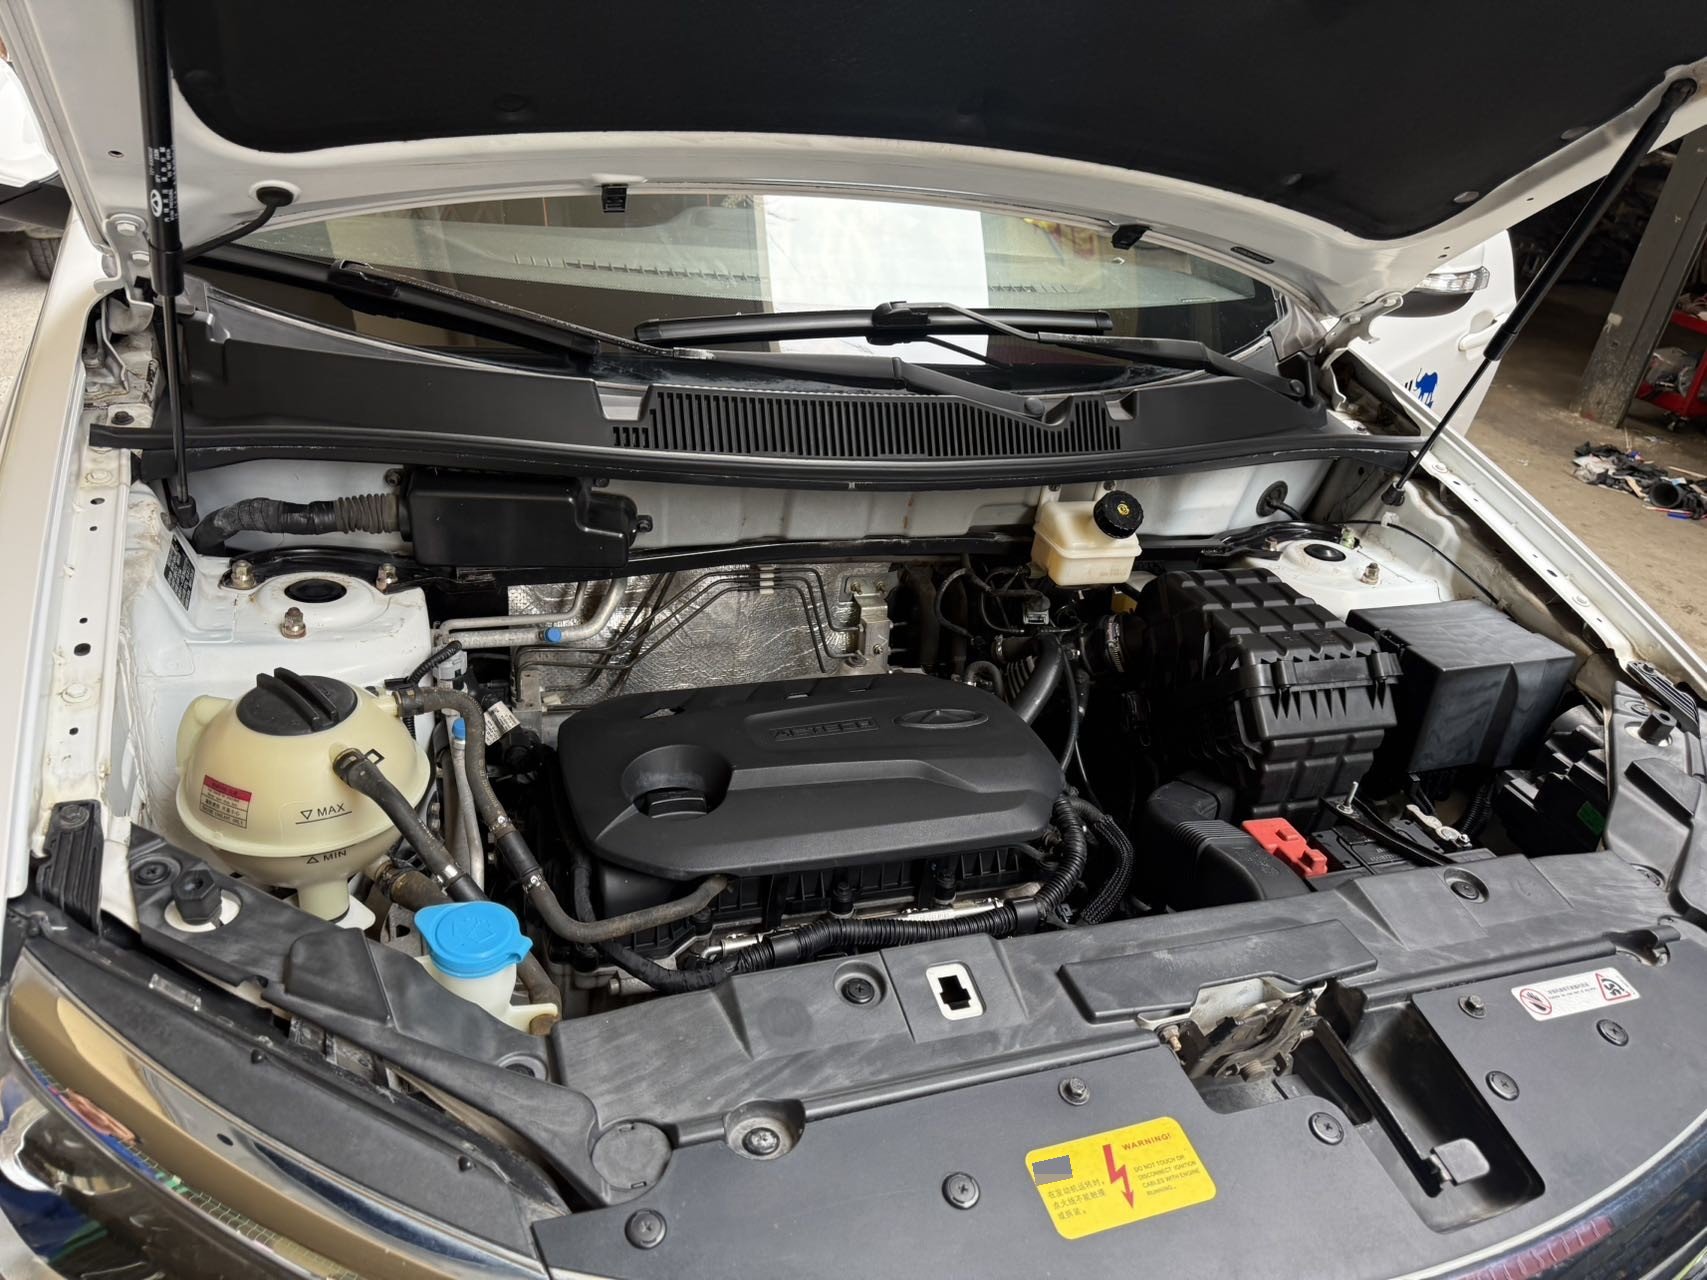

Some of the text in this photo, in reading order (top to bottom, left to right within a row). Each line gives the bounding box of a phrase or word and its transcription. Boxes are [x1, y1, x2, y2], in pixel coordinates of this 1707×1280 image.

[317, 802, 346, 818] MAX
[323, 850, 347, 862] MIN
[1121, 1132, 1171, 1151] WARNING!
[1143, 1161, 1155, 1170] NOT
[1156, 1156, 1176, 1165] TOUCH
